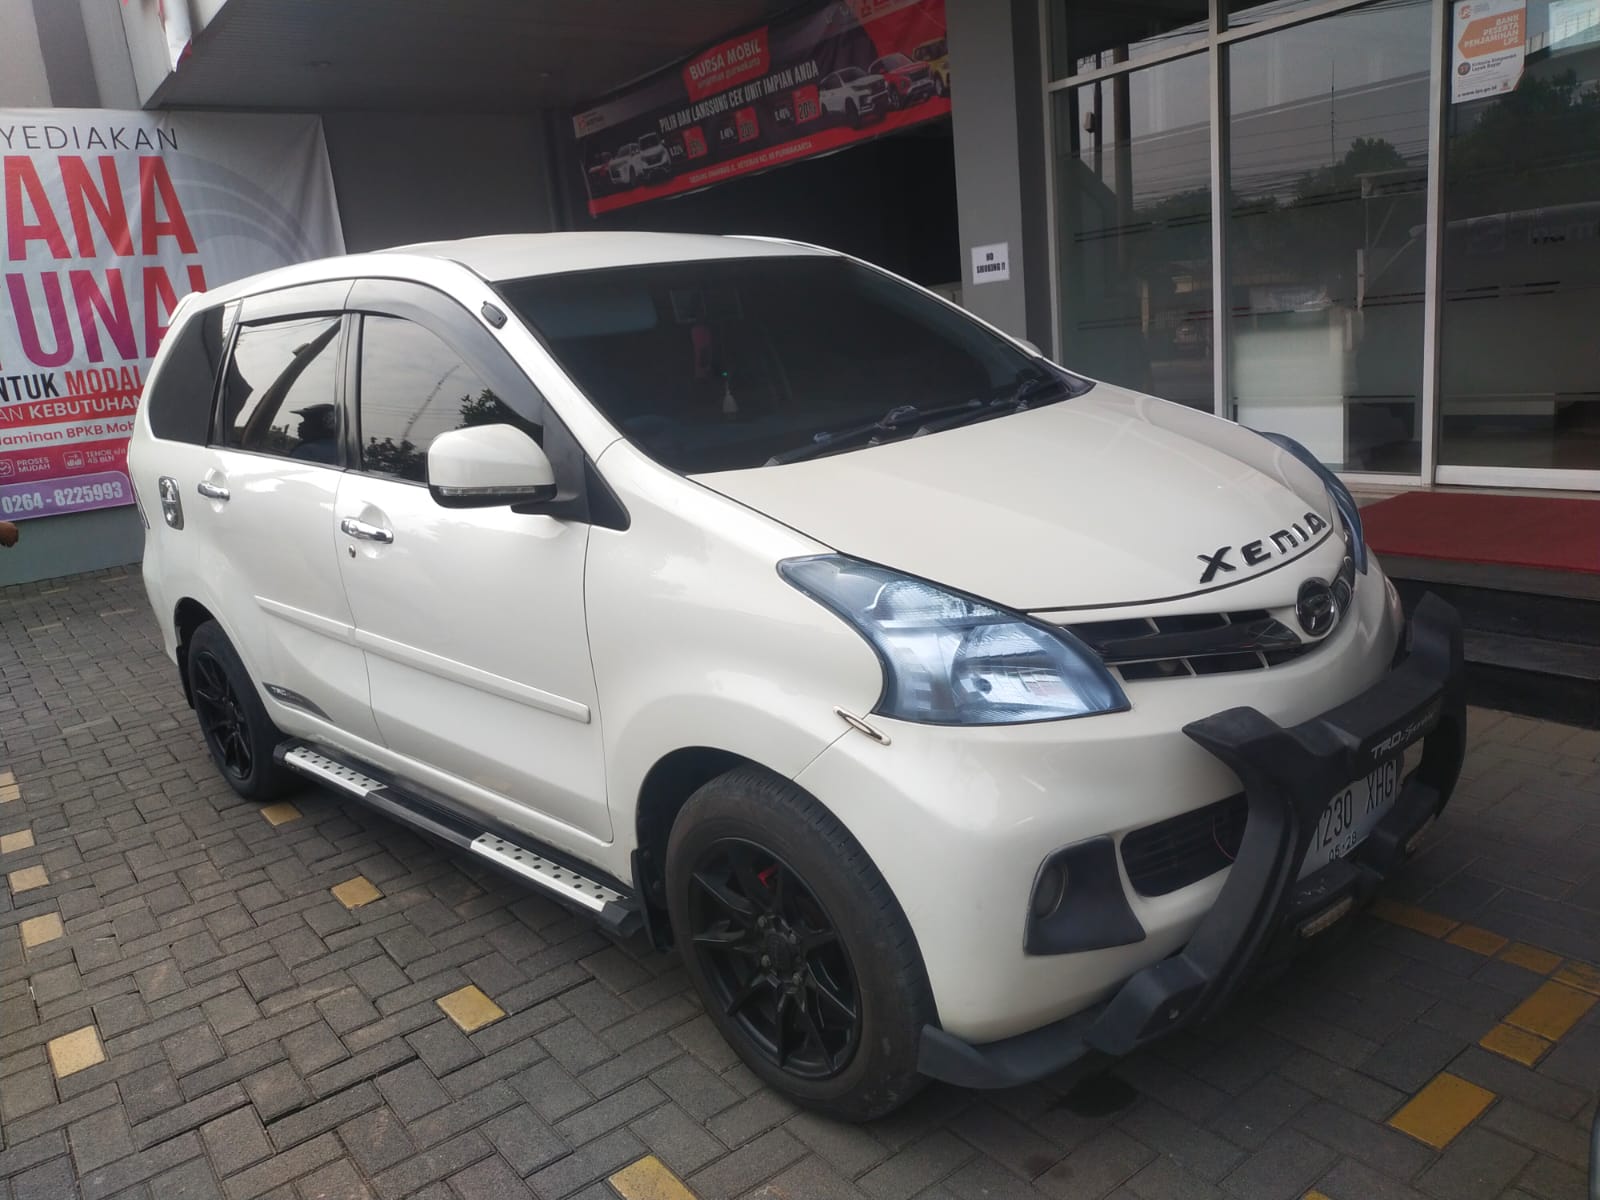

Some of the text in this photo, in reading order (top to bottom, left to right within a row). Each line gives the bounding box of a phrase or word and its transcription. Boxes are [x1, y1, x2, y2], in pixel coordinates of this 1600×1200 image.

[689, 54, 725, 80] BURSA
[727, 39, 761, 65] MOBIL
[795, 60, 819, 83] ANDA
[0, 126, 178, 150] YEDIAKAN
[4, 155, 198, 261] ANA
[976, 262, 1001, 274] SMOKING
[66, 424, 104, 438] BPKB
[17, 457, 49, 466] PROSES
[18, 463, 50, 473] MUDAH
[3, 492, 44, 513] 0264
[54, 481, 123, 507] 8225993
[1197, 512, 1327, 584] XENIA
[1366, 761, 1395, 814] XHG
